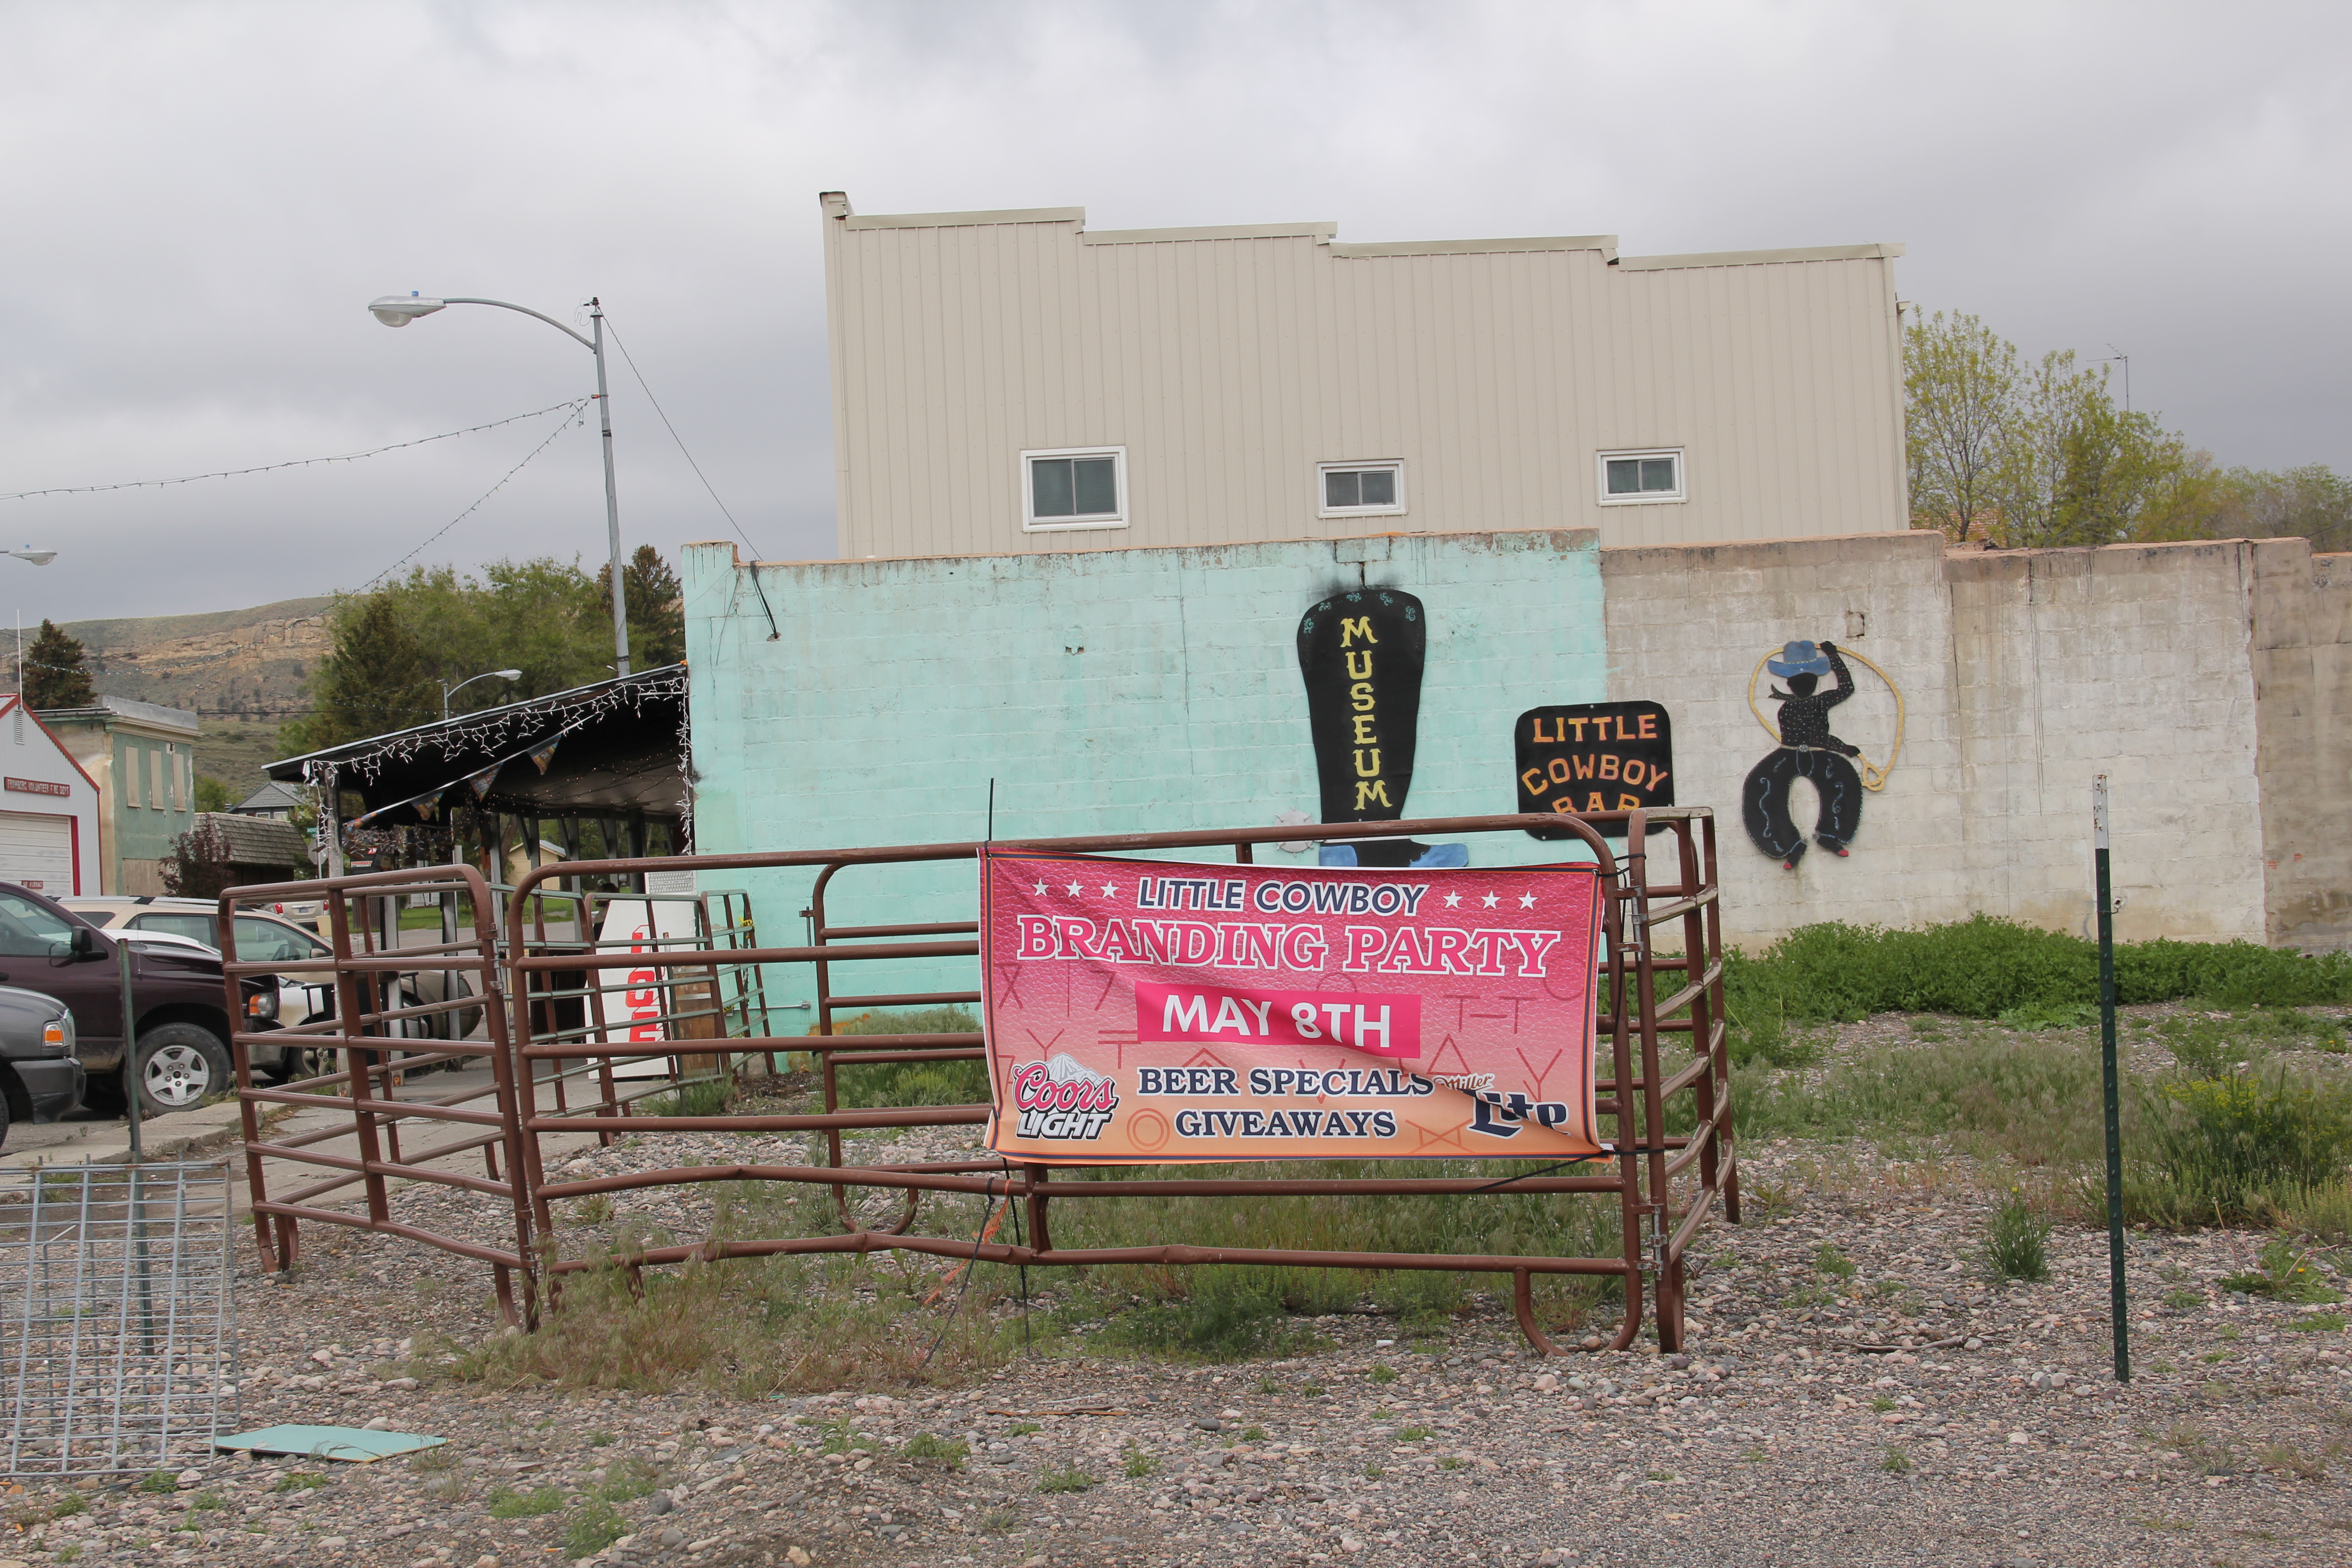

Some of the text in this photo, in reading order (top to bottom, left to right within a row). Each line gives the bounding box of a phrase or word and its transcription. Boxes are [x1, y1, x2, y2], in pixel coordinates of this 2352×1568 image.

[1340, 616, 1393, 811] MUSEUM
[1533, 714, 1657, 743] LITTLE
[28, 782, 49, 793] VOLUNTEER
[50, 784, 59, 794] FRE
[1522, 754, 1668, 796] COWBOY
[1137, 877, 1430, 916] LITTLE COWBOY
[1017, 914, 1562, 978] BRANDING PARTY
[1162, 994, 1391, 1048] MAY 8TH
[1012, 1060, 1120, 1113] Coors
[1136, 1066, 1436, 1098] BEER SPECIALS
[1431, 1073, 1495, 1090] Miller
[1015, 1111, 1114, 1141] LIGHT
[1173, 1107, 1398, 1140] GIVEAWAYS
[1466, 1089, 1571, 1139] Lite
